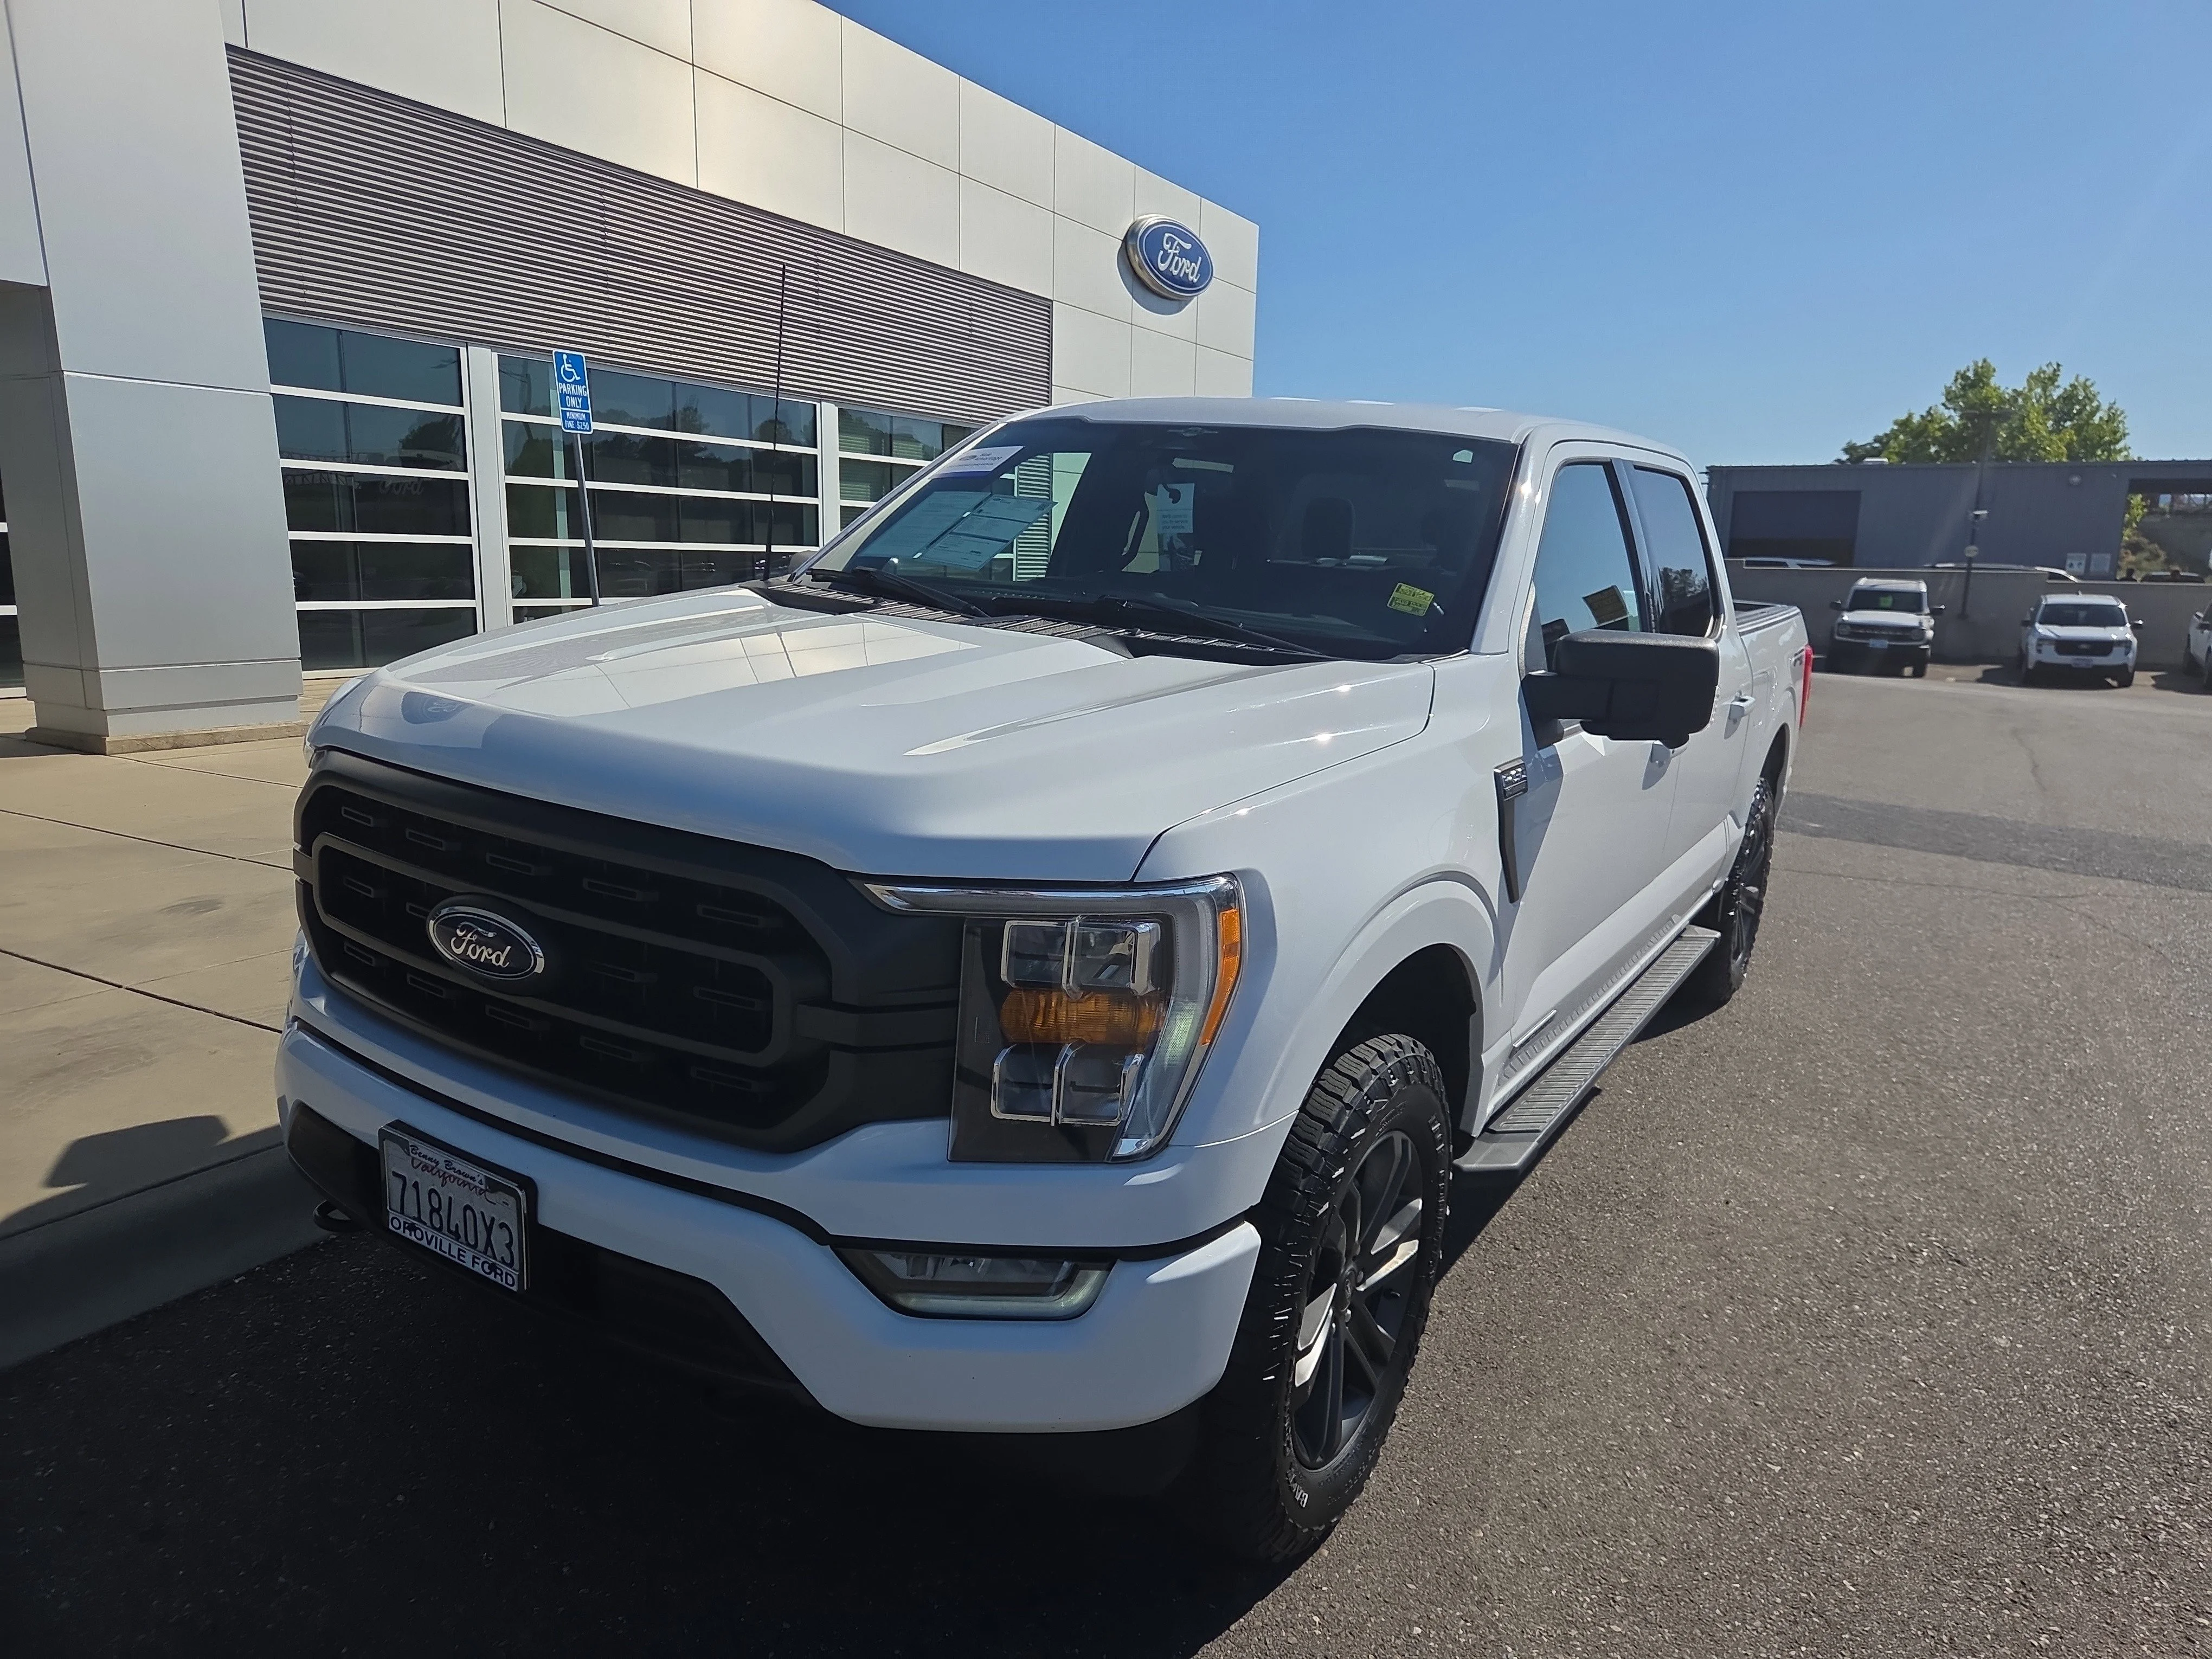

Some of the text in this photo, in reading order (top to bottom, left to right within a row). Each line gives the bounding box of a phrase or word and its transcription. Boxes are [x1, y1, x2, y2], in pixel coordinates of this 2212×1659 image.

[1157, 232, 1202, 283] Ford
[558, 382, 587, 397] PARKING
[565, 396, 582, 408] ONLY
[564, 420, 589, 430] FINE $250
[566, 411, 586, 421] MINIMUM
[450, 921, 512, 968] Ford
[409, 1144, 484, 1186] Benny Brown's
[390, 1216, 515, 1288] OROVILLE FORD
